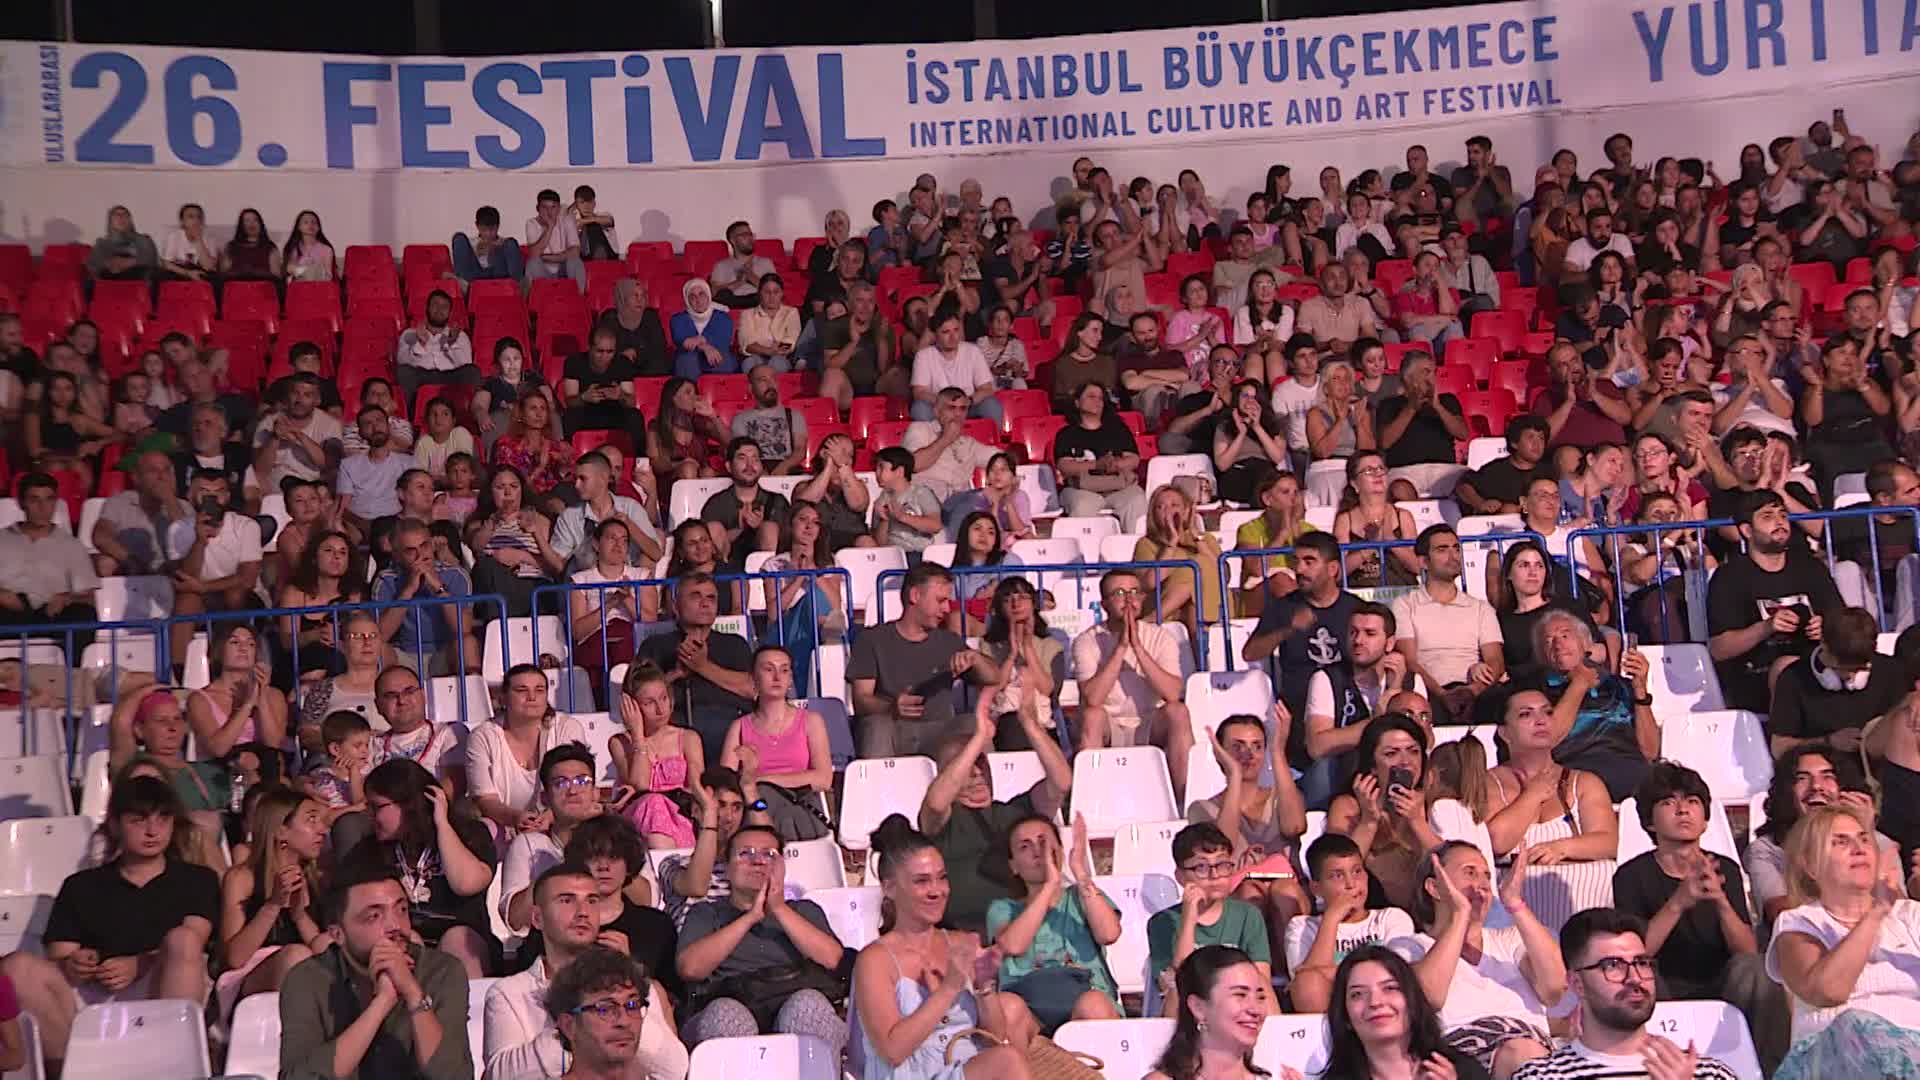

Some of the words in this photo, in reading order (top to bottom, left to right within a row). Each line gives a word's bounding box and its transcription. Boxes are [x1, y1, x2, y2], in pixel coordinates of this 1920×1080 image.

[906, 49, 1143, 104] İSTANBUL
[1163, 16, 1560, 90] BÜYÜKÇEKMECE
[40, 45, 64, 162] ULUSLARARASI
[70, 52, 288, 166] 26.
[910, 111, 1136, 147] INTERNATIONAL
[1148, 101, 1273, 134] CULTURE
[1286, 96, 1342, 126] AND
[1356, 91, 1410, 120] ART
[1423, 79, 1562, 115] FESTIVAL
[884, 760, 896, 769] 10
[1116, 758, 1128, 767] 12
[1160, 830, 1172, 840] 13
[786, 849, 799, 858] 10
[1124, 888, 1137, 898] 11
[850, 901, 857, 911] 9
[1659, 1019, 1678, 1034] 12
[1120, 1040, 1130, 1052] 9
[759, 1047, 767, 1060] 7
